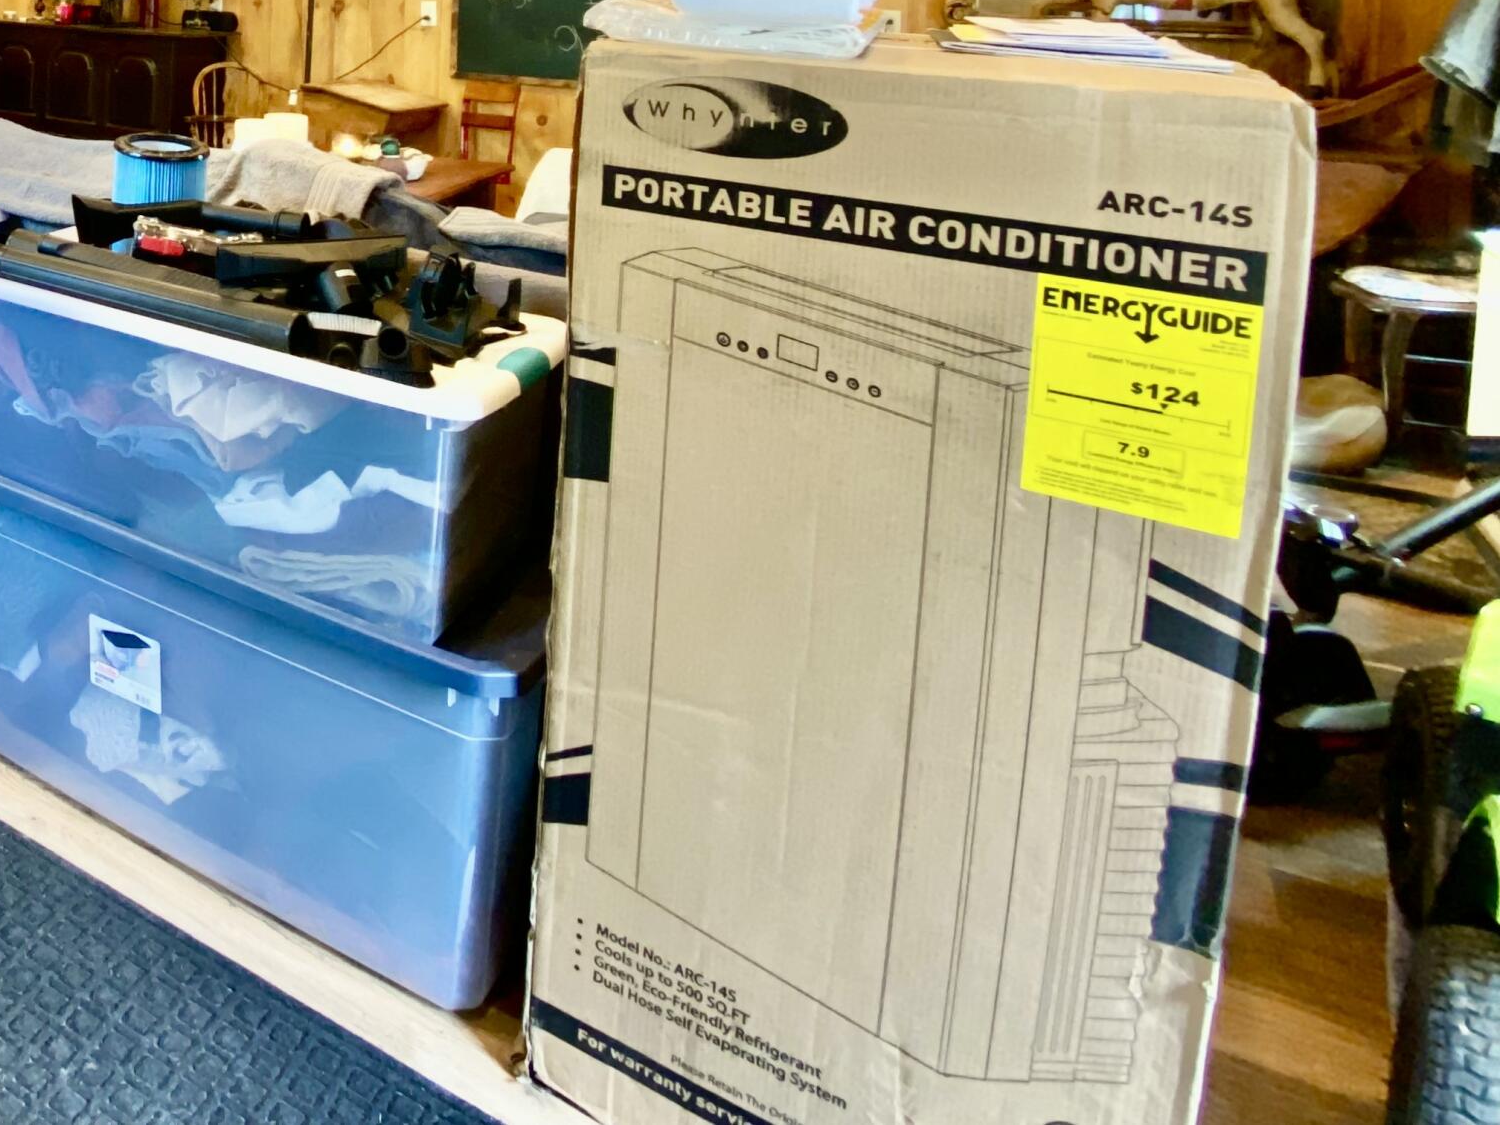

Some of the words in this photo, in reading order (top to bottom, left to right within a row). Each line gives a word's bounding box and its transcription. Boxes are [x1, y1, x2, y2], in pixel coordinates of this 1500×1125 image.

[613, 173, 814, 228] PORTABLE
[822, 203, 896, 242] AIR
[908, 214, 1249, 292] CONDITIONER
[1096, 190, 1254, 228] ARC-14S
[1130, 381, 1201, 408] $124
[1117, 441, 1150, 459] 7.9
[595, 939, 633, 967] Cools
[636, 960, 654, 978] up
[658, 971, 673, 987] to
[676, 981, 704, 1003] 500
[596, 923, 640, 954] Model
[674, 963, 738, 1003] ARC-14S
[592, 970, 624, 996] Dual
[627, 988, 663, 1015] Hose
[666, 1008, 692, 1031] Self
[695, 1026, 786, 1082] Evaporating
[789, 1071, 848, 1111] System
[593, 955, 639, 988] Green,
[642, 979, 731, 1034] Eco-Friendly
[735, 1025, 823, 1080] Refrigerant
[576, 1027, 608, 1055] For
[610, 1046, 692, 1102] warranty
[670, 1054, 705, 1080] Please
[708, 1074, 743, 1100] Retain
[746, 1093, 766, 1112] The
